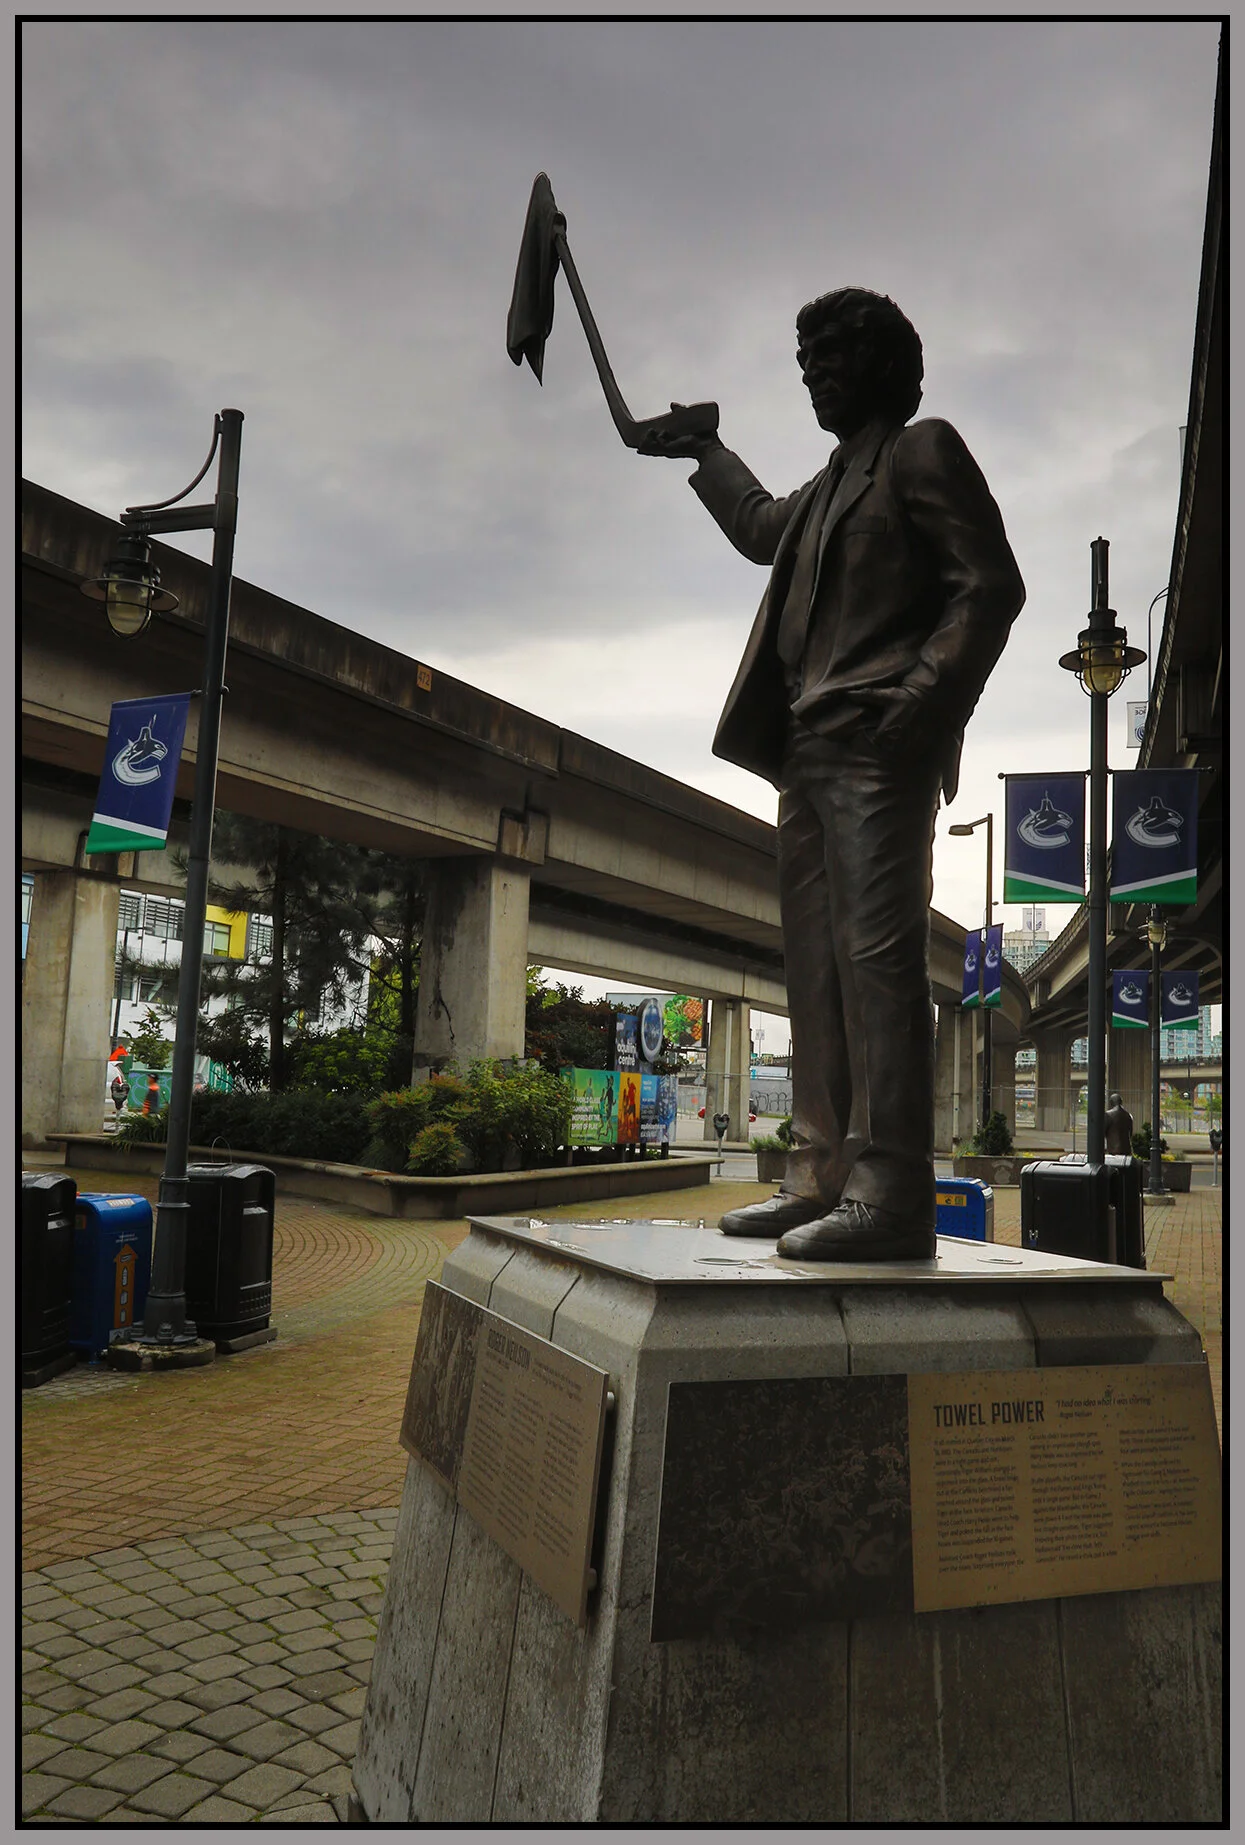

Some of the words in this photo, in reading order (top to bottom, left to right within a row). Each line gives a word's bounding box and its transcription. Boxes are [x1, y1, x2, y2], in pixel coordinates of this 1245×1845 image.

[618, 1054, 636, 1066] centre
[1061, 1398, 1073, 1407] had
[1083, 1399, 1096, 1407] idea
[1097, 1398, 1112, 1406] what
[933, 1403, 986, 1427] TOWEL
[991, 1400, 1045, 1424] POWER
